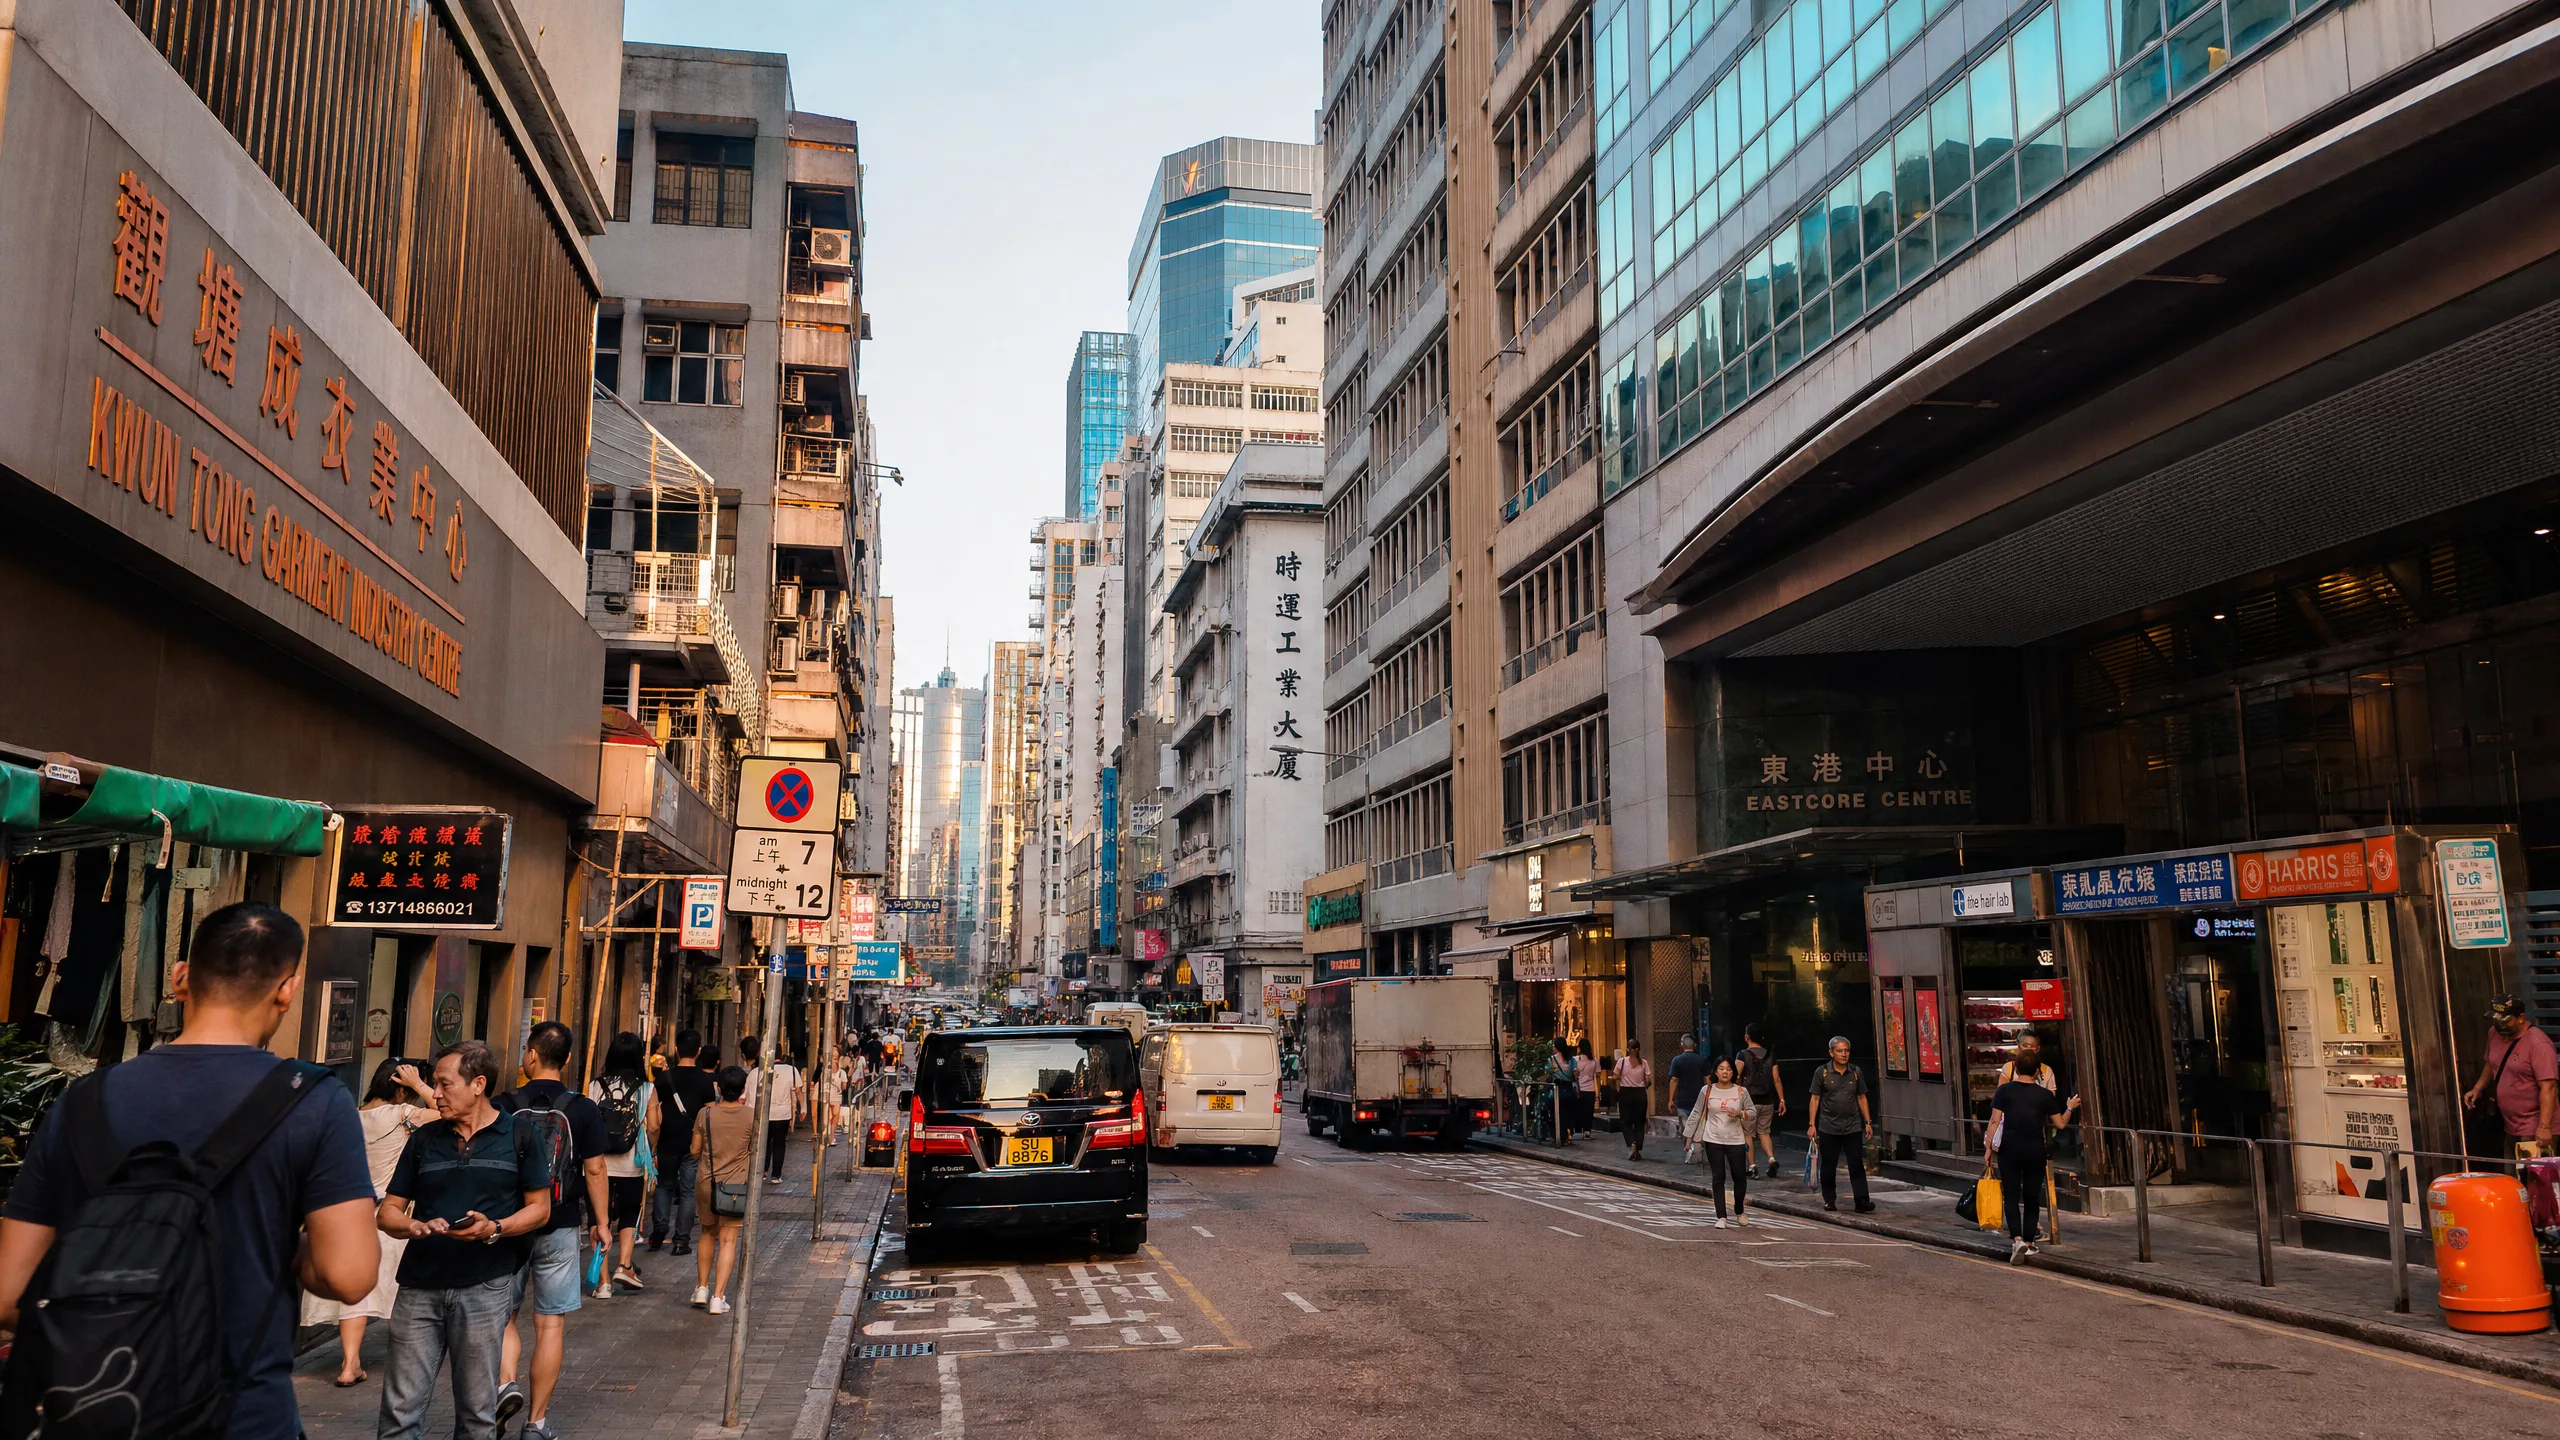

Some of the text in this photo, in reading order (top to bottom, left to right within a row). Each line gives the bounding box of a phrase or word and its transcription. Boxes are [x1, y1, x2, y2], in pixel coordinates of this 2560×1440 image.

[113, 169, 468, 583] 觀塘成衣業中心
[88, 376, 463, 698] KWUN TONG GARMENT INDUSTRY CENTRE
[1273, 550, 1303, 781] 時運工業大廈
[1760, 749, 1949, 785] 東港中心
[1746, 789, 1973, 812] EASTCORE CENTRE
[758, 836, 778, 847] am
[752, 848, 781, 864] 上午
[801, 840, 816, 865] 7
[2266, 853, 2340, 884] HARRIS
[736, 875, 788, 892] midnight
[747, 891, 776, 906] 下午
[795, 883, 824, 909] 12
[1980, 892, 1996, 909] hair
[1996, 891, 2010, 907] lab
[366, 900, 474, 916] 13714866021
[1020, 1138, 1039, 1150] SU
[1011, 1149, 1049, 1163] 8876
